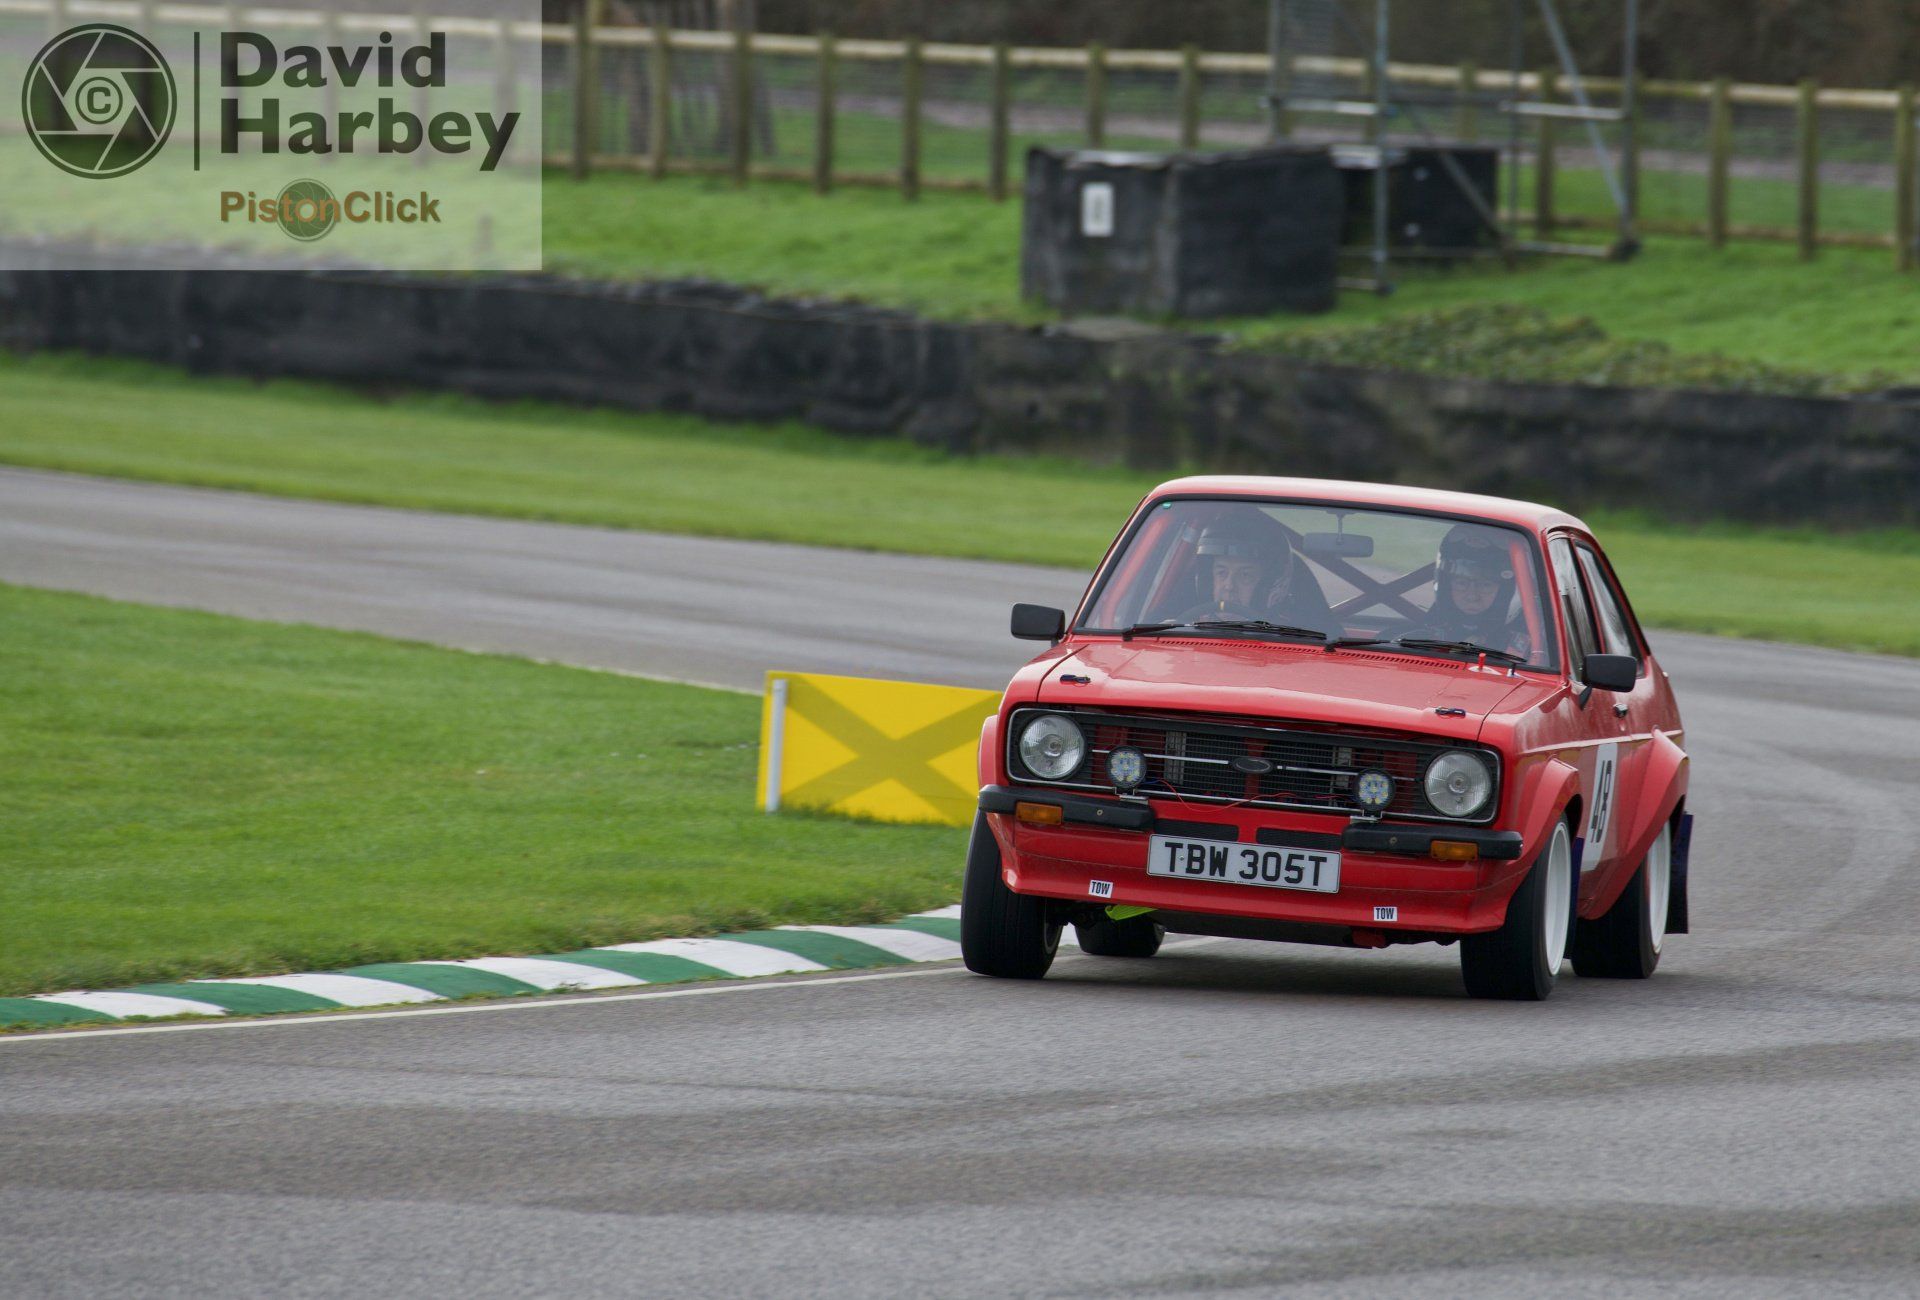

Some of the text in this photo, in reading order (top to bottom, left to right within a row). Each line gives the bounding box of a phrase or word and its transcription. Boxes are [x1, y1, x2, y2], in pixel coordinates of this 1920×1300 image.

[1164, 841, 1328, 887] TBW 305T
[1091, 880, 1111, 895] TOW
[1375, 907, 1395, 920] TOW
